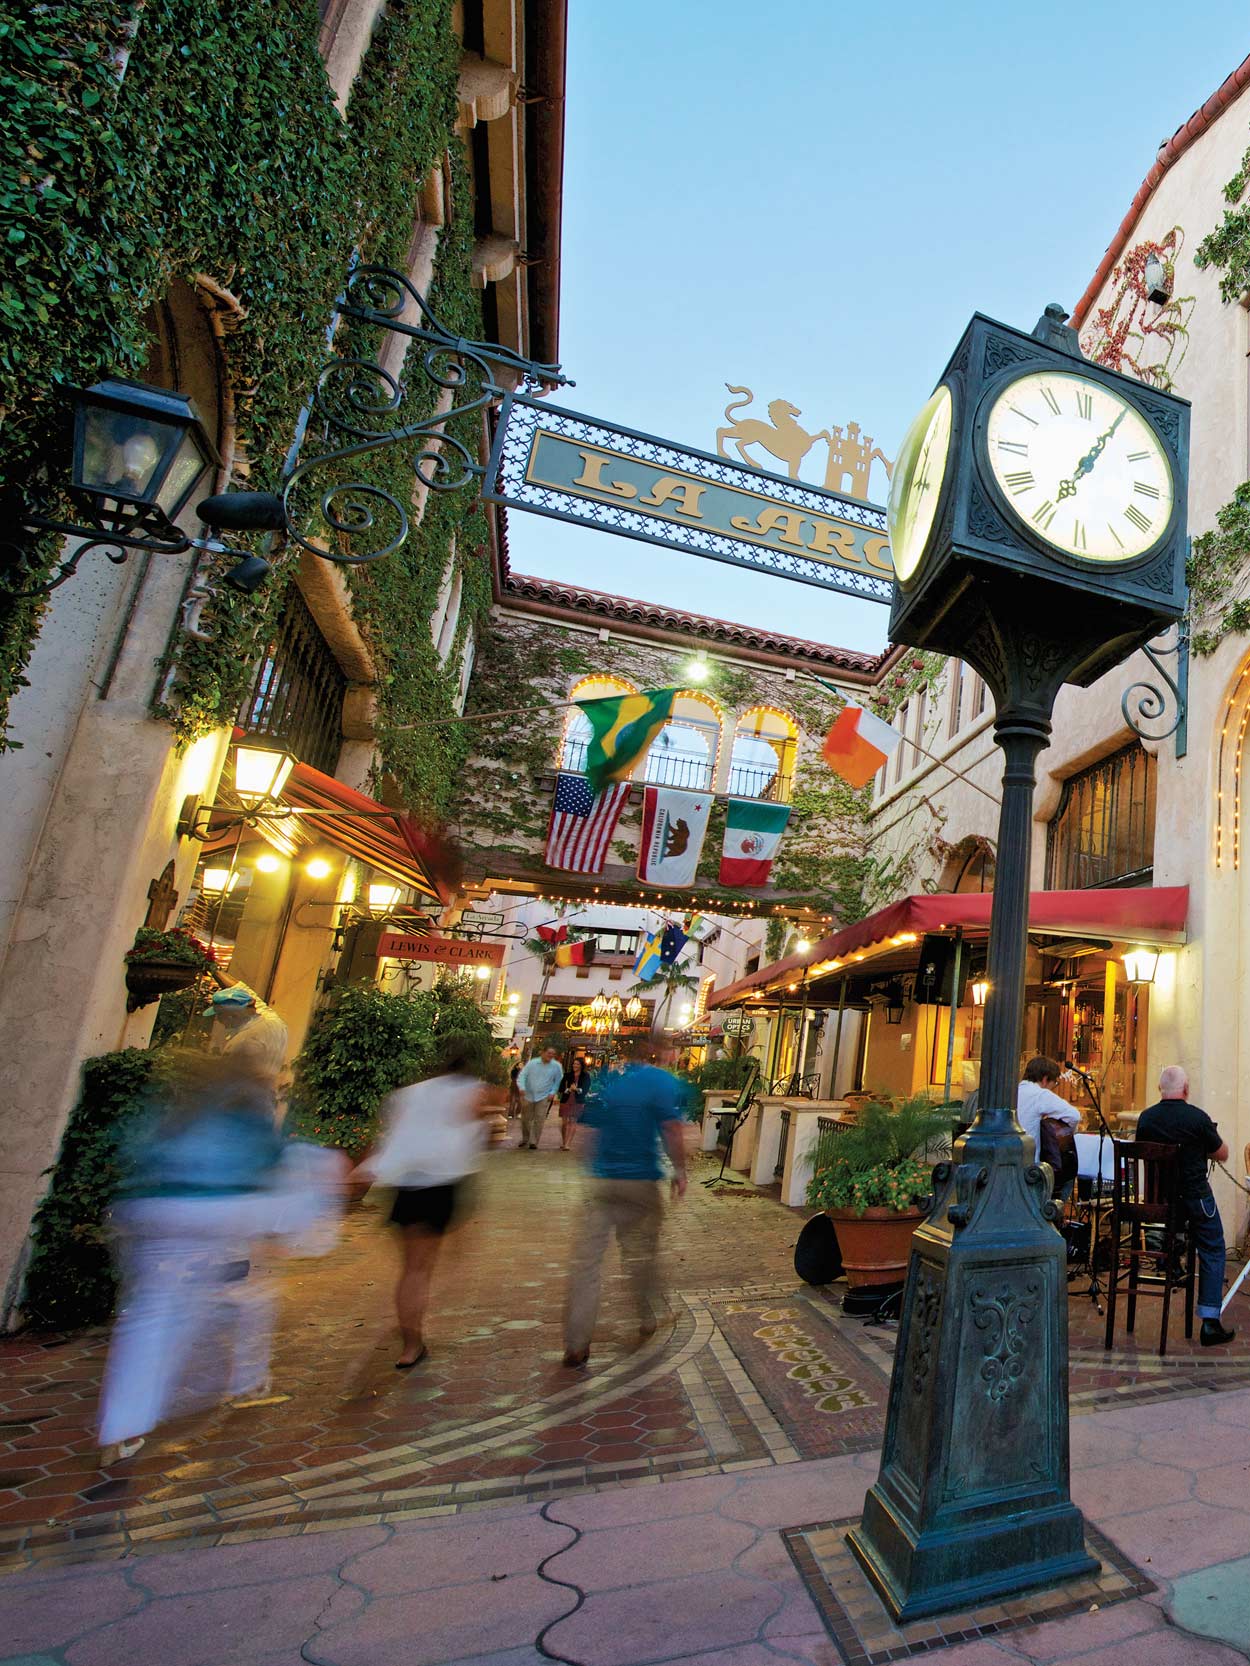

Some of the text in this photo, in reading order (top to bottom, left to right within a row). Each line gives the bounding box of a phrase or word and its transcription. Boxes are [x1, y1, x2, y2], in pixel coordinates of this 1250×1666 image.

[572, 451, 708, 520] LA
[650, 808, 666, 866] CALIFORNIA REPUBLIC
[390, 940, 494, 960] LEWIS & CLARK
[726, 1023, 751, 1031] OPTCS
